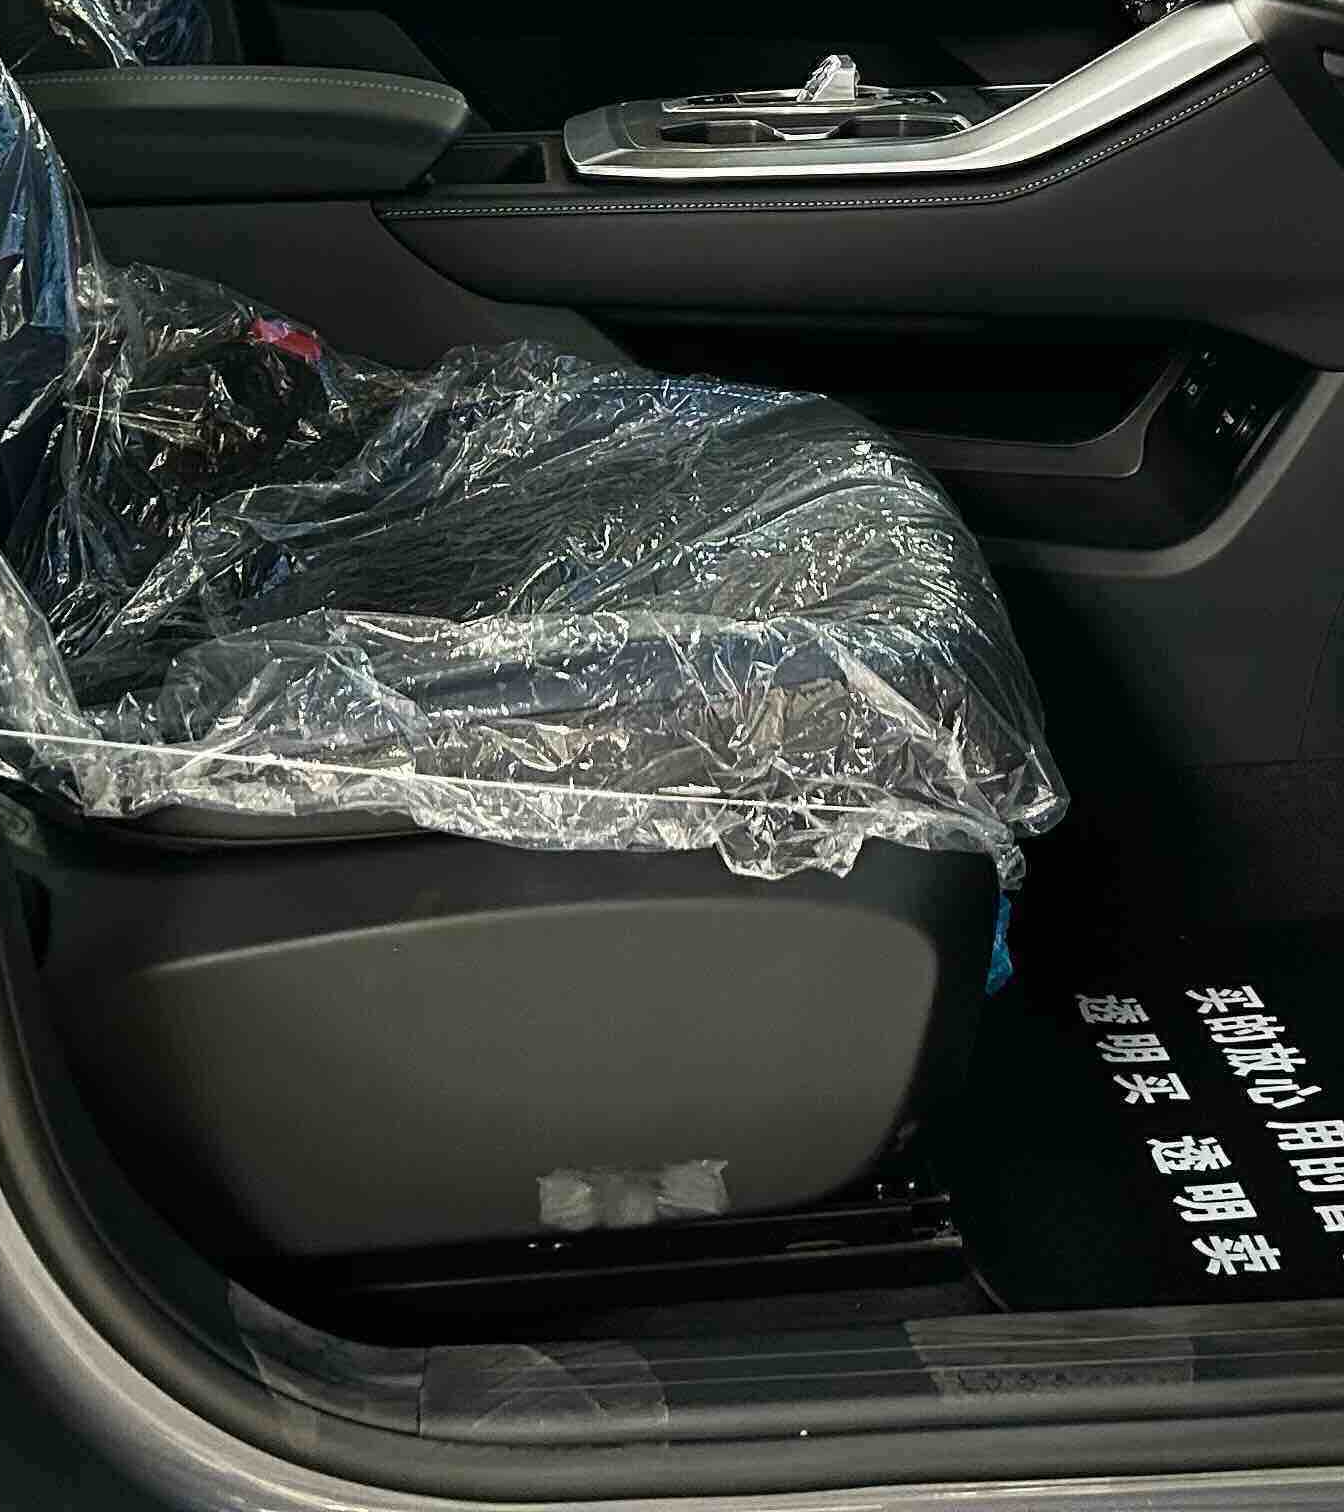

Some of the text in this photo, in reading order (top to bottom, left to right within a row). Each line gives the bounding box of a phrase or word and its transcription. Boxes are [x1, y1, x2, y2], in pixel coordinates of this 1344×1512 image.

[1074, 993, 1281, 1276] 透明买 透明卖
[1185, 985, 1322, 1110] 买的放心
